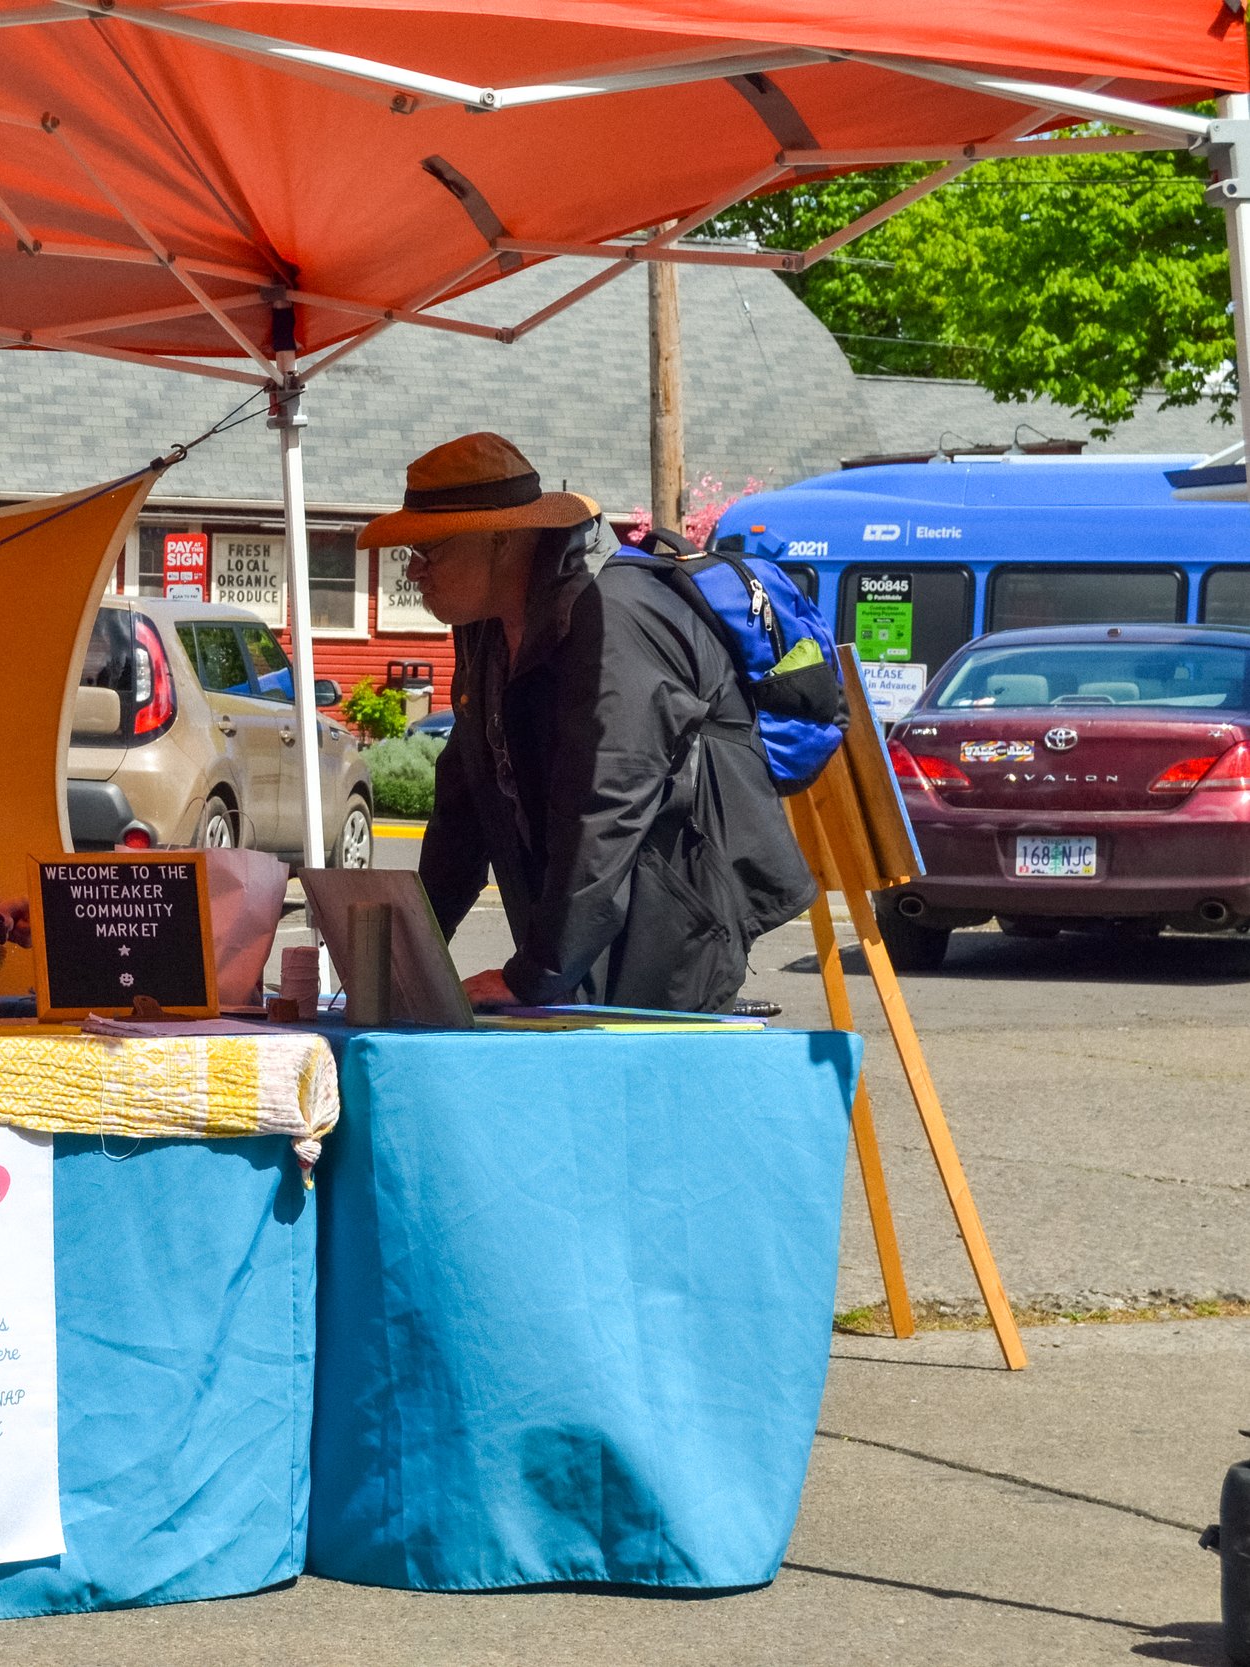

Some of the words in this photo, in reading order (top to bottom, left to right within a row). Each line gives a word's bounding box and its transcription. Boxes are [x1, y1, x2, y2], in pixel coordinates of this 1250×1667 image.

[916, 526, 962, 538] Electric
[167, 541, 193, 553] PAY
[228, 543, 270, 557] FRESH
[788, 541, 828, 556] 20211
[167, 553, 204, 566] SIGN
[227, 559, 269, 572] LOCAL
[217, 574, 277, 587] ORGANIC
[395, 579, 419, 592] SOU
[861, 580, 909, 592] 300845
[219, 590, 278, 603] PRODUCE
[388, 594, 422, 606] SAMM
[864, 669, 903, 679] PLEASE
[880, 681, 917, 690] Advance
[1003, 774, 1118, 782] AVALON
[1023, 846, 1050, 866] 168
[1062, 846, 1092, 866] NJC
[45, 866, 119, 880] WELCOME
[130, 866, 150, 880] TO
[158, 865, 188, 879] THE
[70, 885, 163, 899] WHITEAKER
[75, 903, 173, 918] COMMUNITY
[96, 923, 158, 937] MARKET
